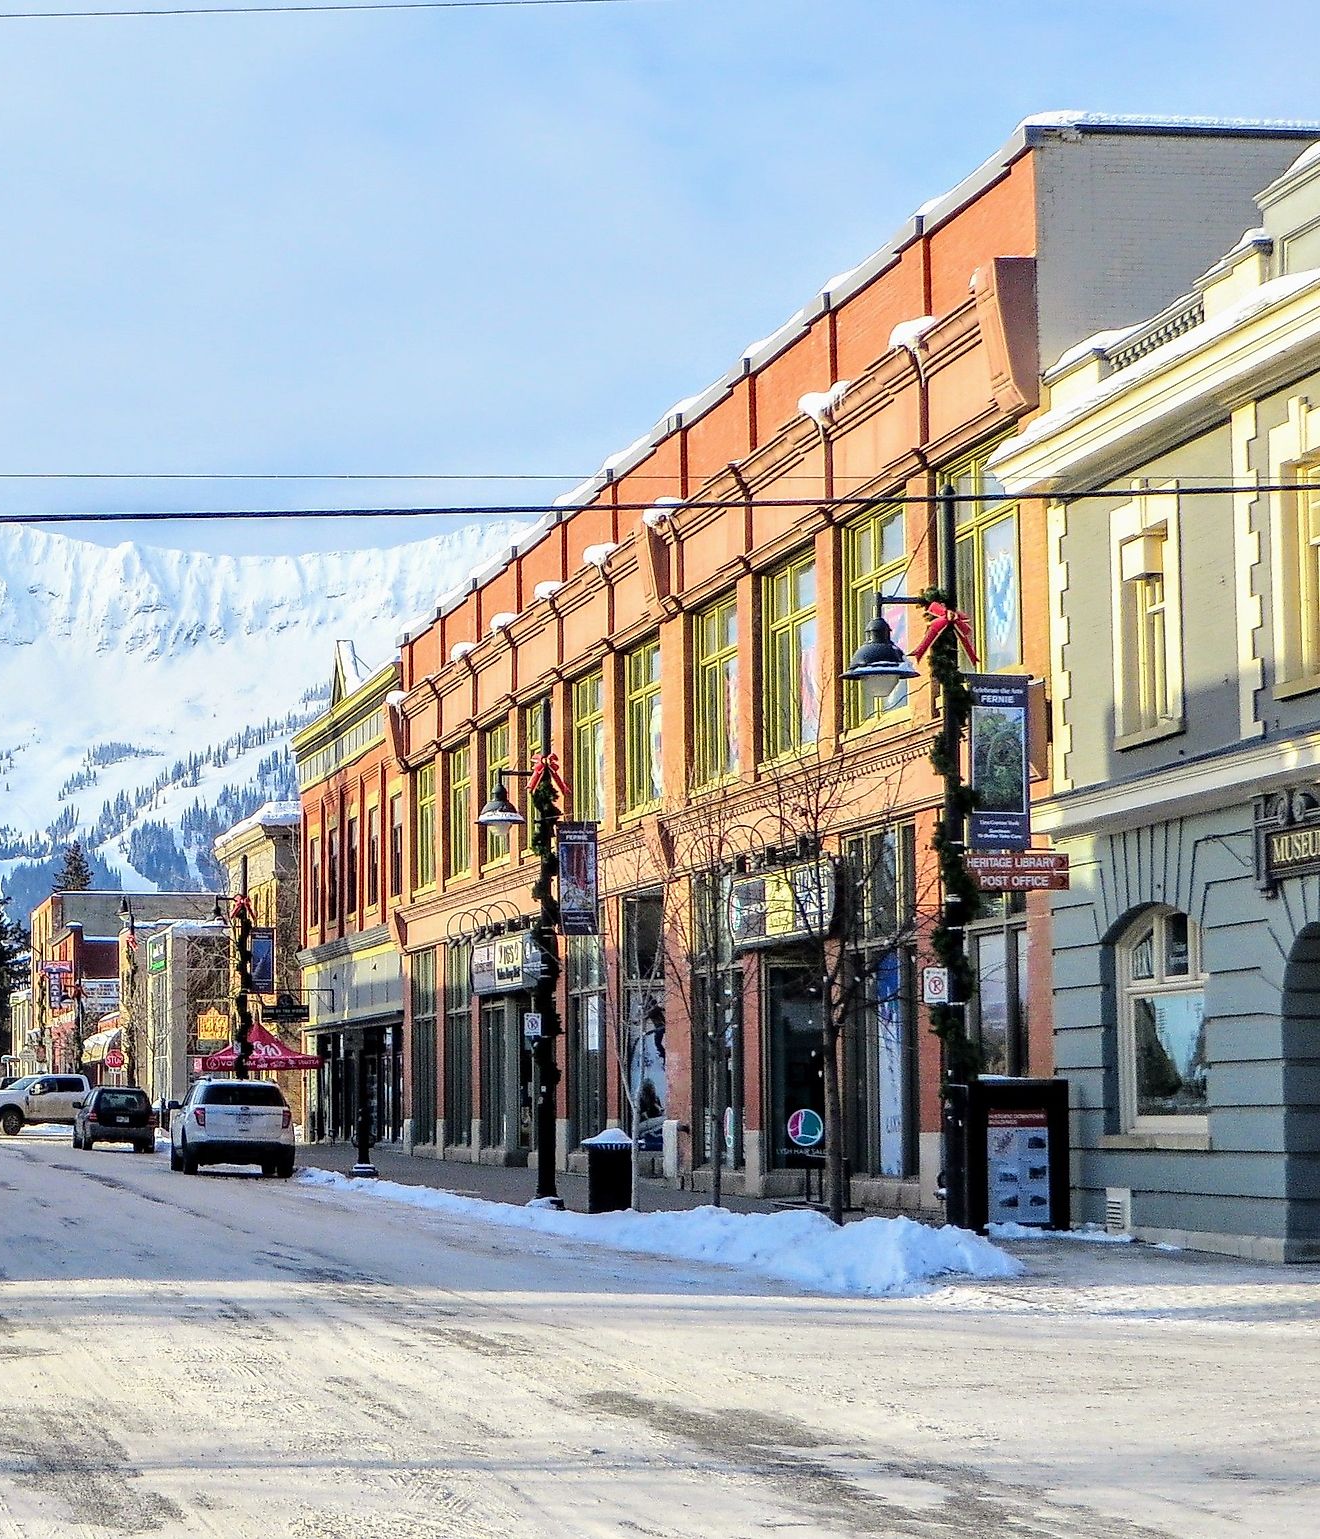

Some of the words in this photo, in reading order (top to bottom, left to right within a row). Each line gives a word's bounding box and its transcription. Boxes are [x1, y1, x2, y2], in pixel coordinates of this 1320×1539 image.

[980, 695, 1015, 704] FERNIE
[966, 857, 1013, 868] HERITAGE
[1014, 857, 1055, 868] LIBRARY
[980, 875, 1010, 886] POST
[1011, 876, 1050, 887] OFFICE
